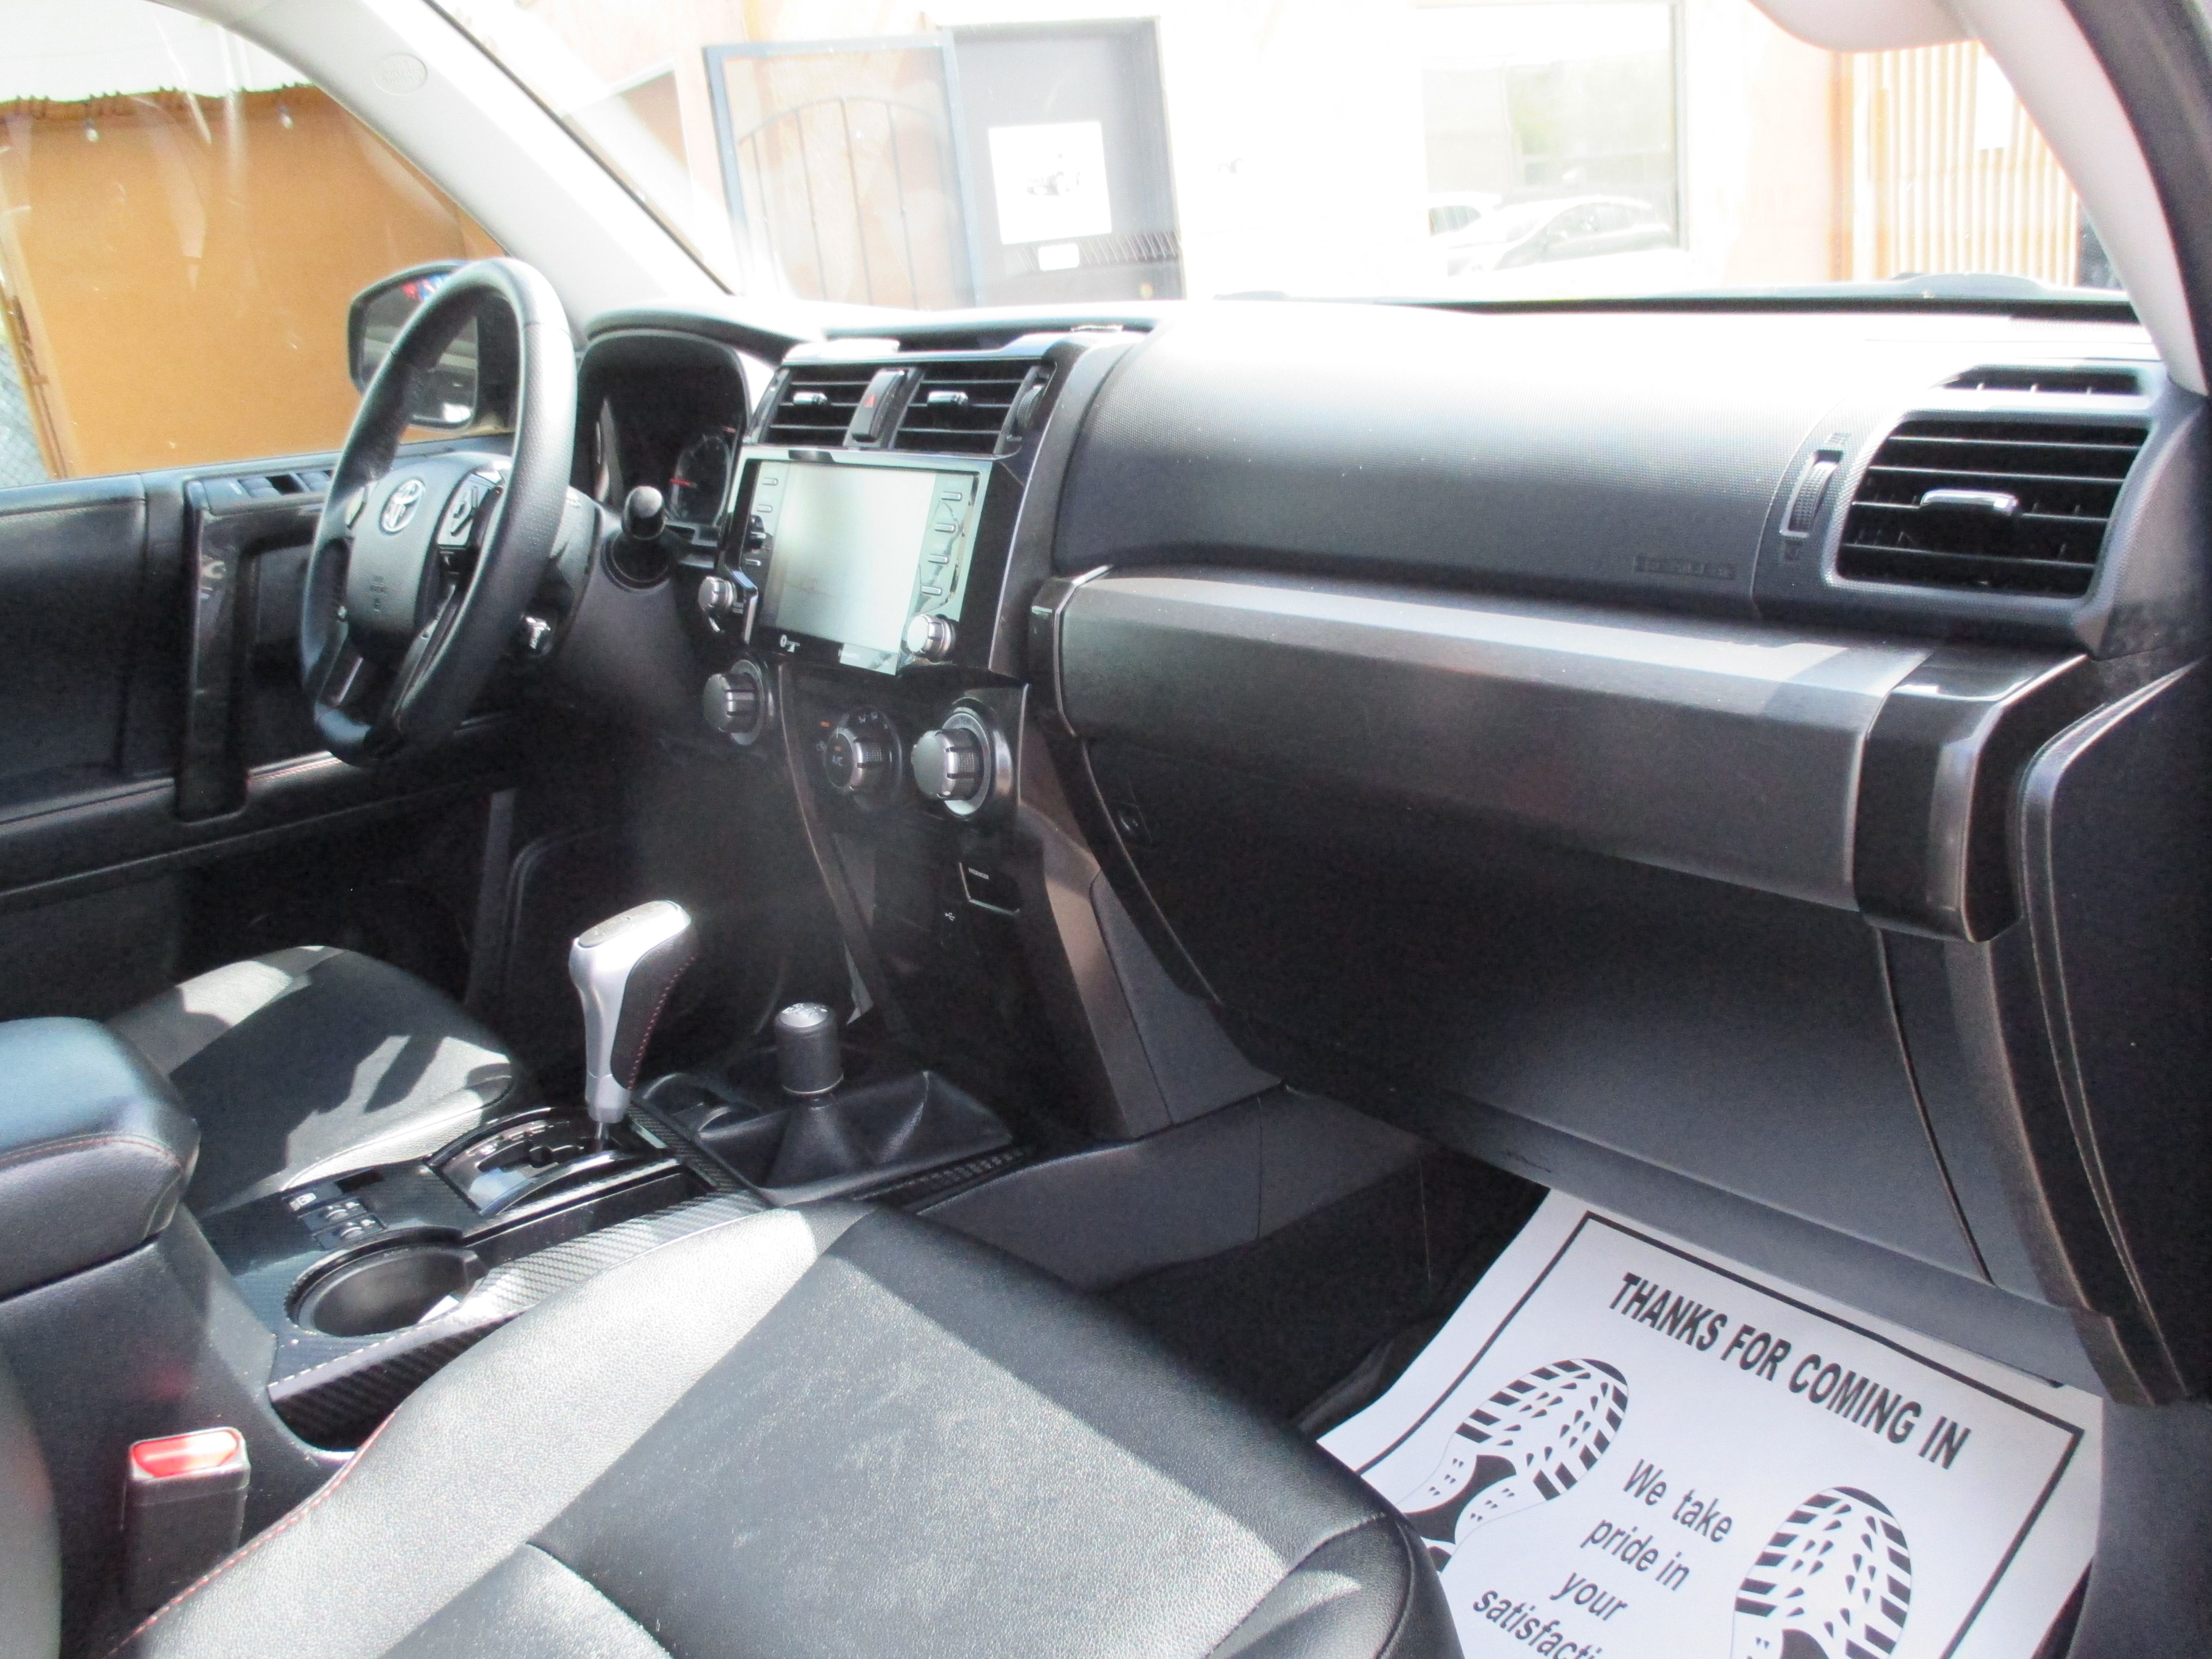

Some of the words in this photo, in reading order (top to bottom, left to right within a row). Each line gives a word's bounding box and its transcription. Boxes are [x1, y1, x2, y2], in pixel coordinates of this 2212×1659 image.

[1609, 1272, 1728, 1351] THANKS
[1720, 1323, 1791, 1382] FOR
[1789, 1354, 1922, 1444] COMING
[1918, 1415, 1972, 1470] IN
[1623, 1459, 1667, 1505] We
[1672, 1489, 1732, 1543] take
[1580, 1519, 1659, 1572] pride
[1656, 1551, 1690, 1590] in
[1550, 1572, 1628, 1621] your
